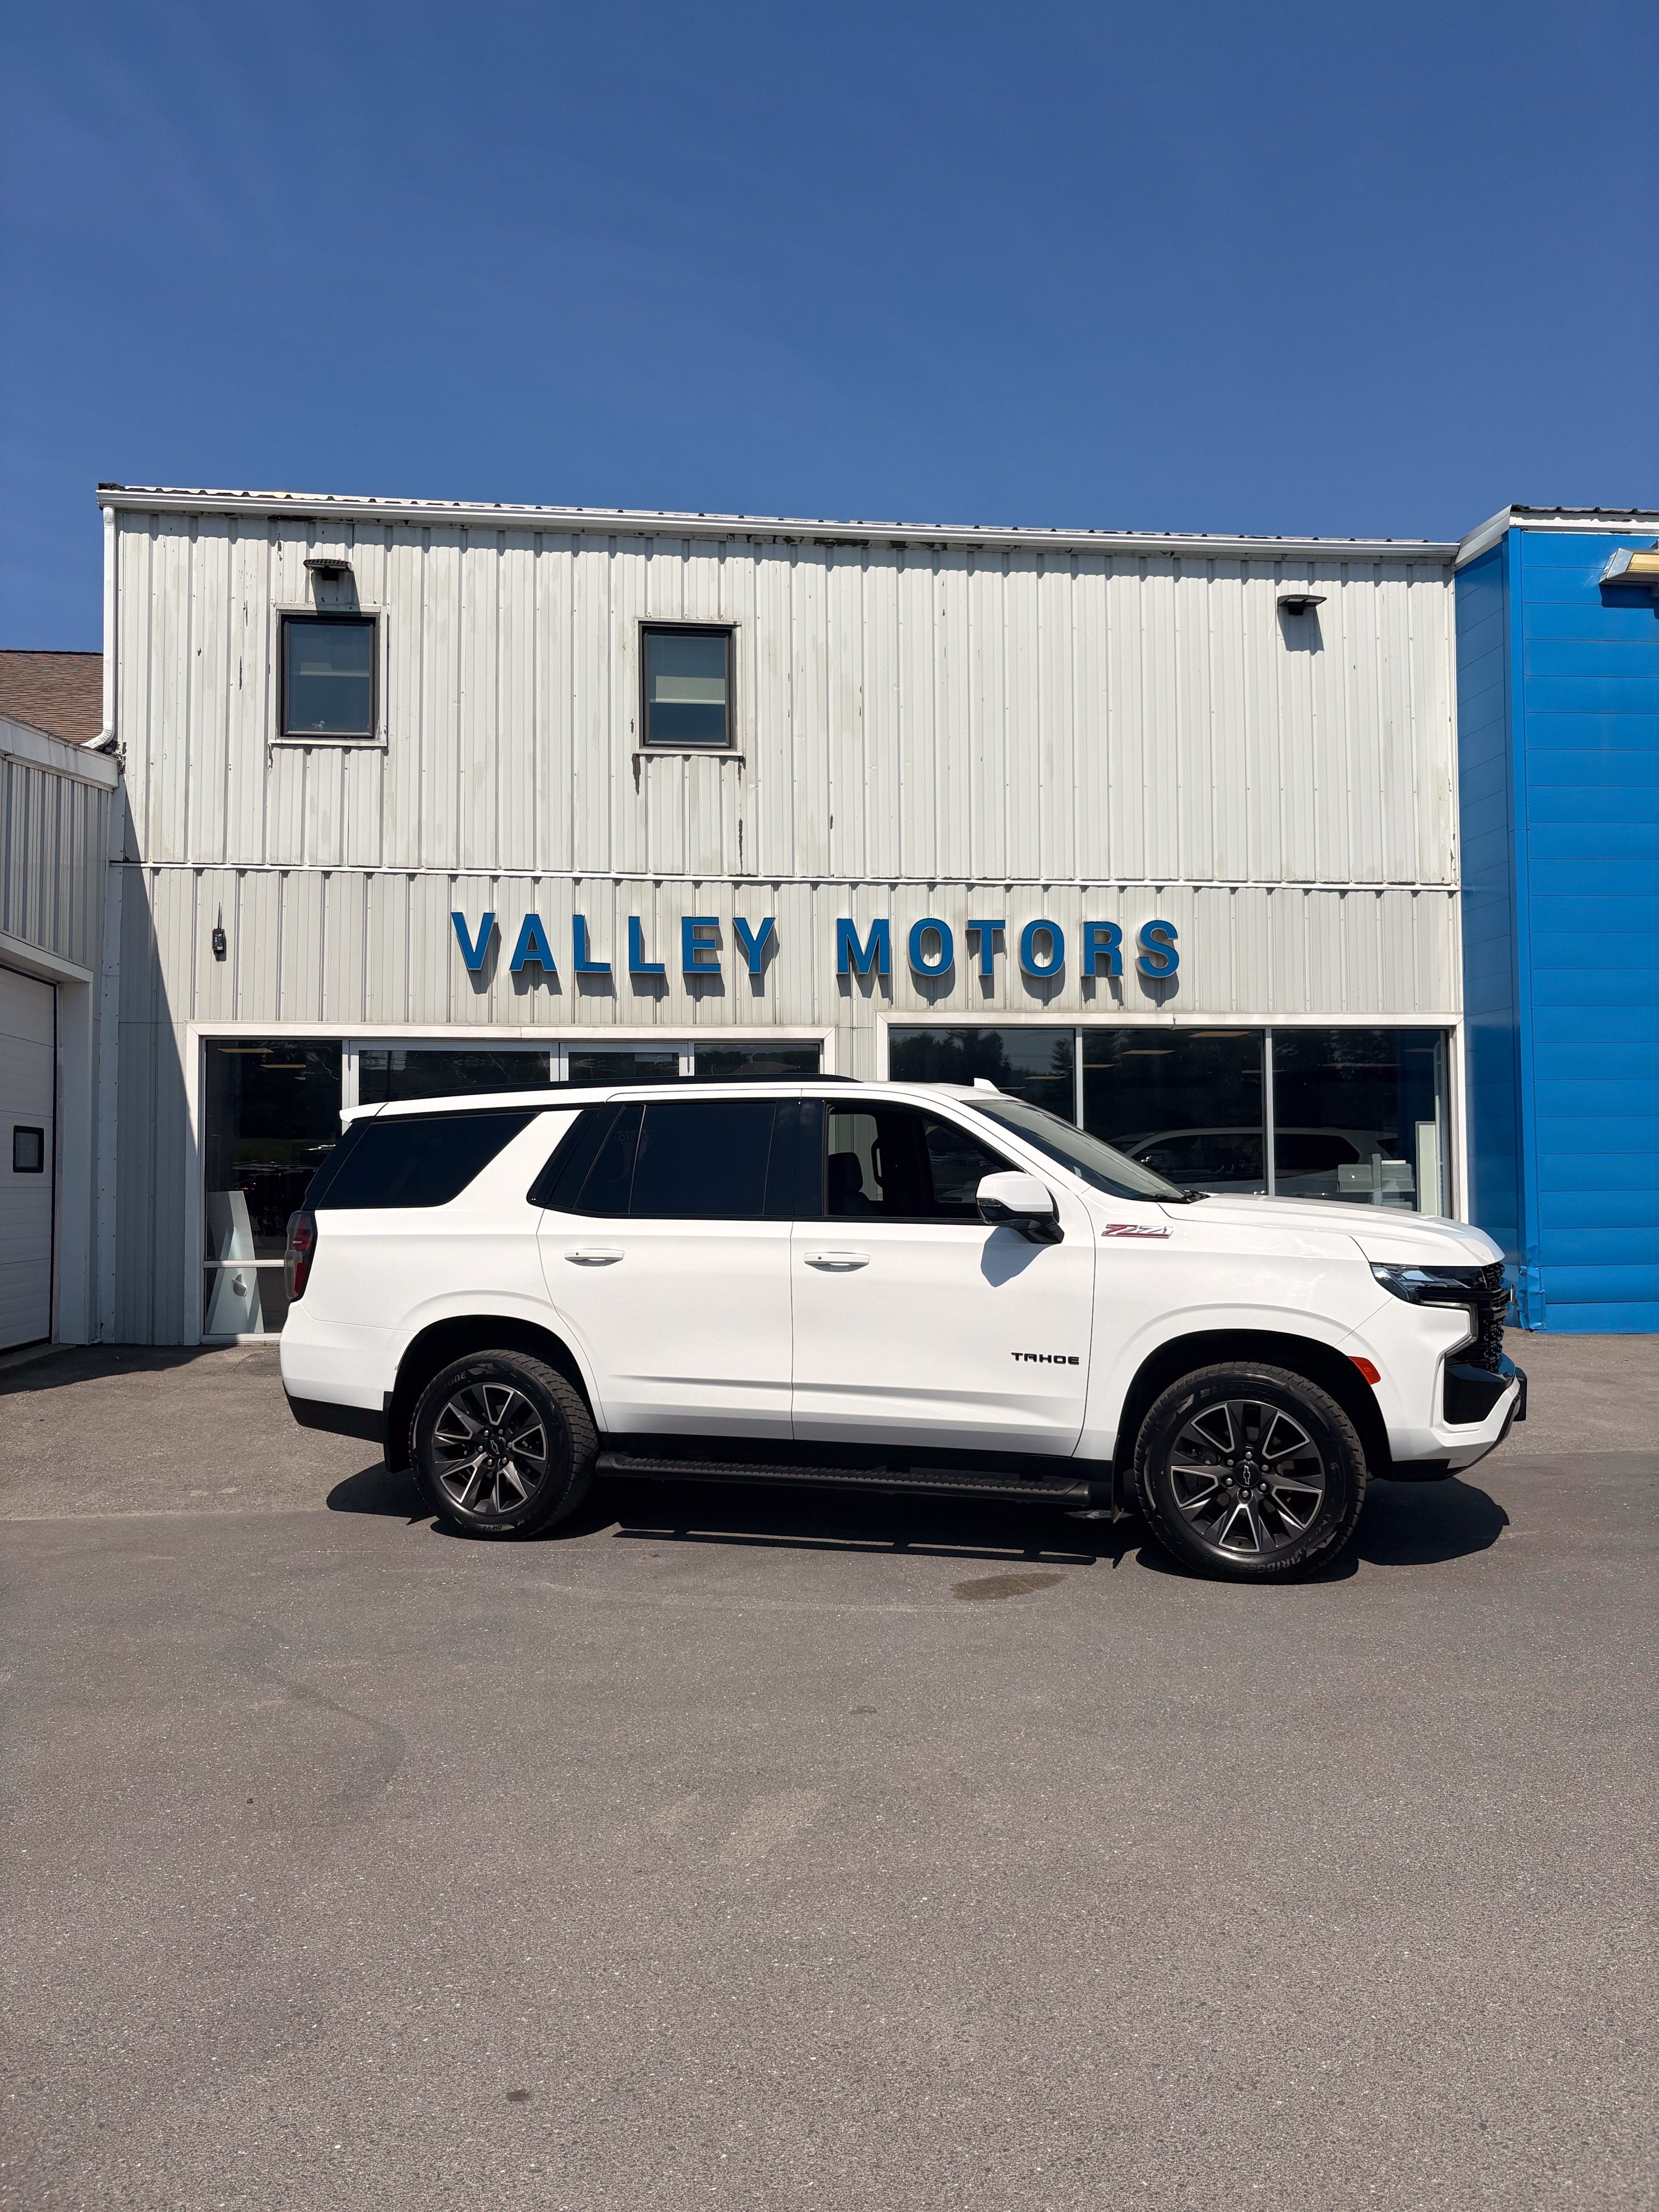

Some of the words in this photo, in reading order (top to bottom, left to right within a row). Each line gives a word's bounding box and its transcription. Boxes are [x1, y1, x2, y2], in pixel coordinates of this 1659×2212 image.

[451, 912, 776, 974] VALLEY
[836, 918, 1179, 979] MOTORS
[1011, 1352, 1079, 1366] TAHOE
